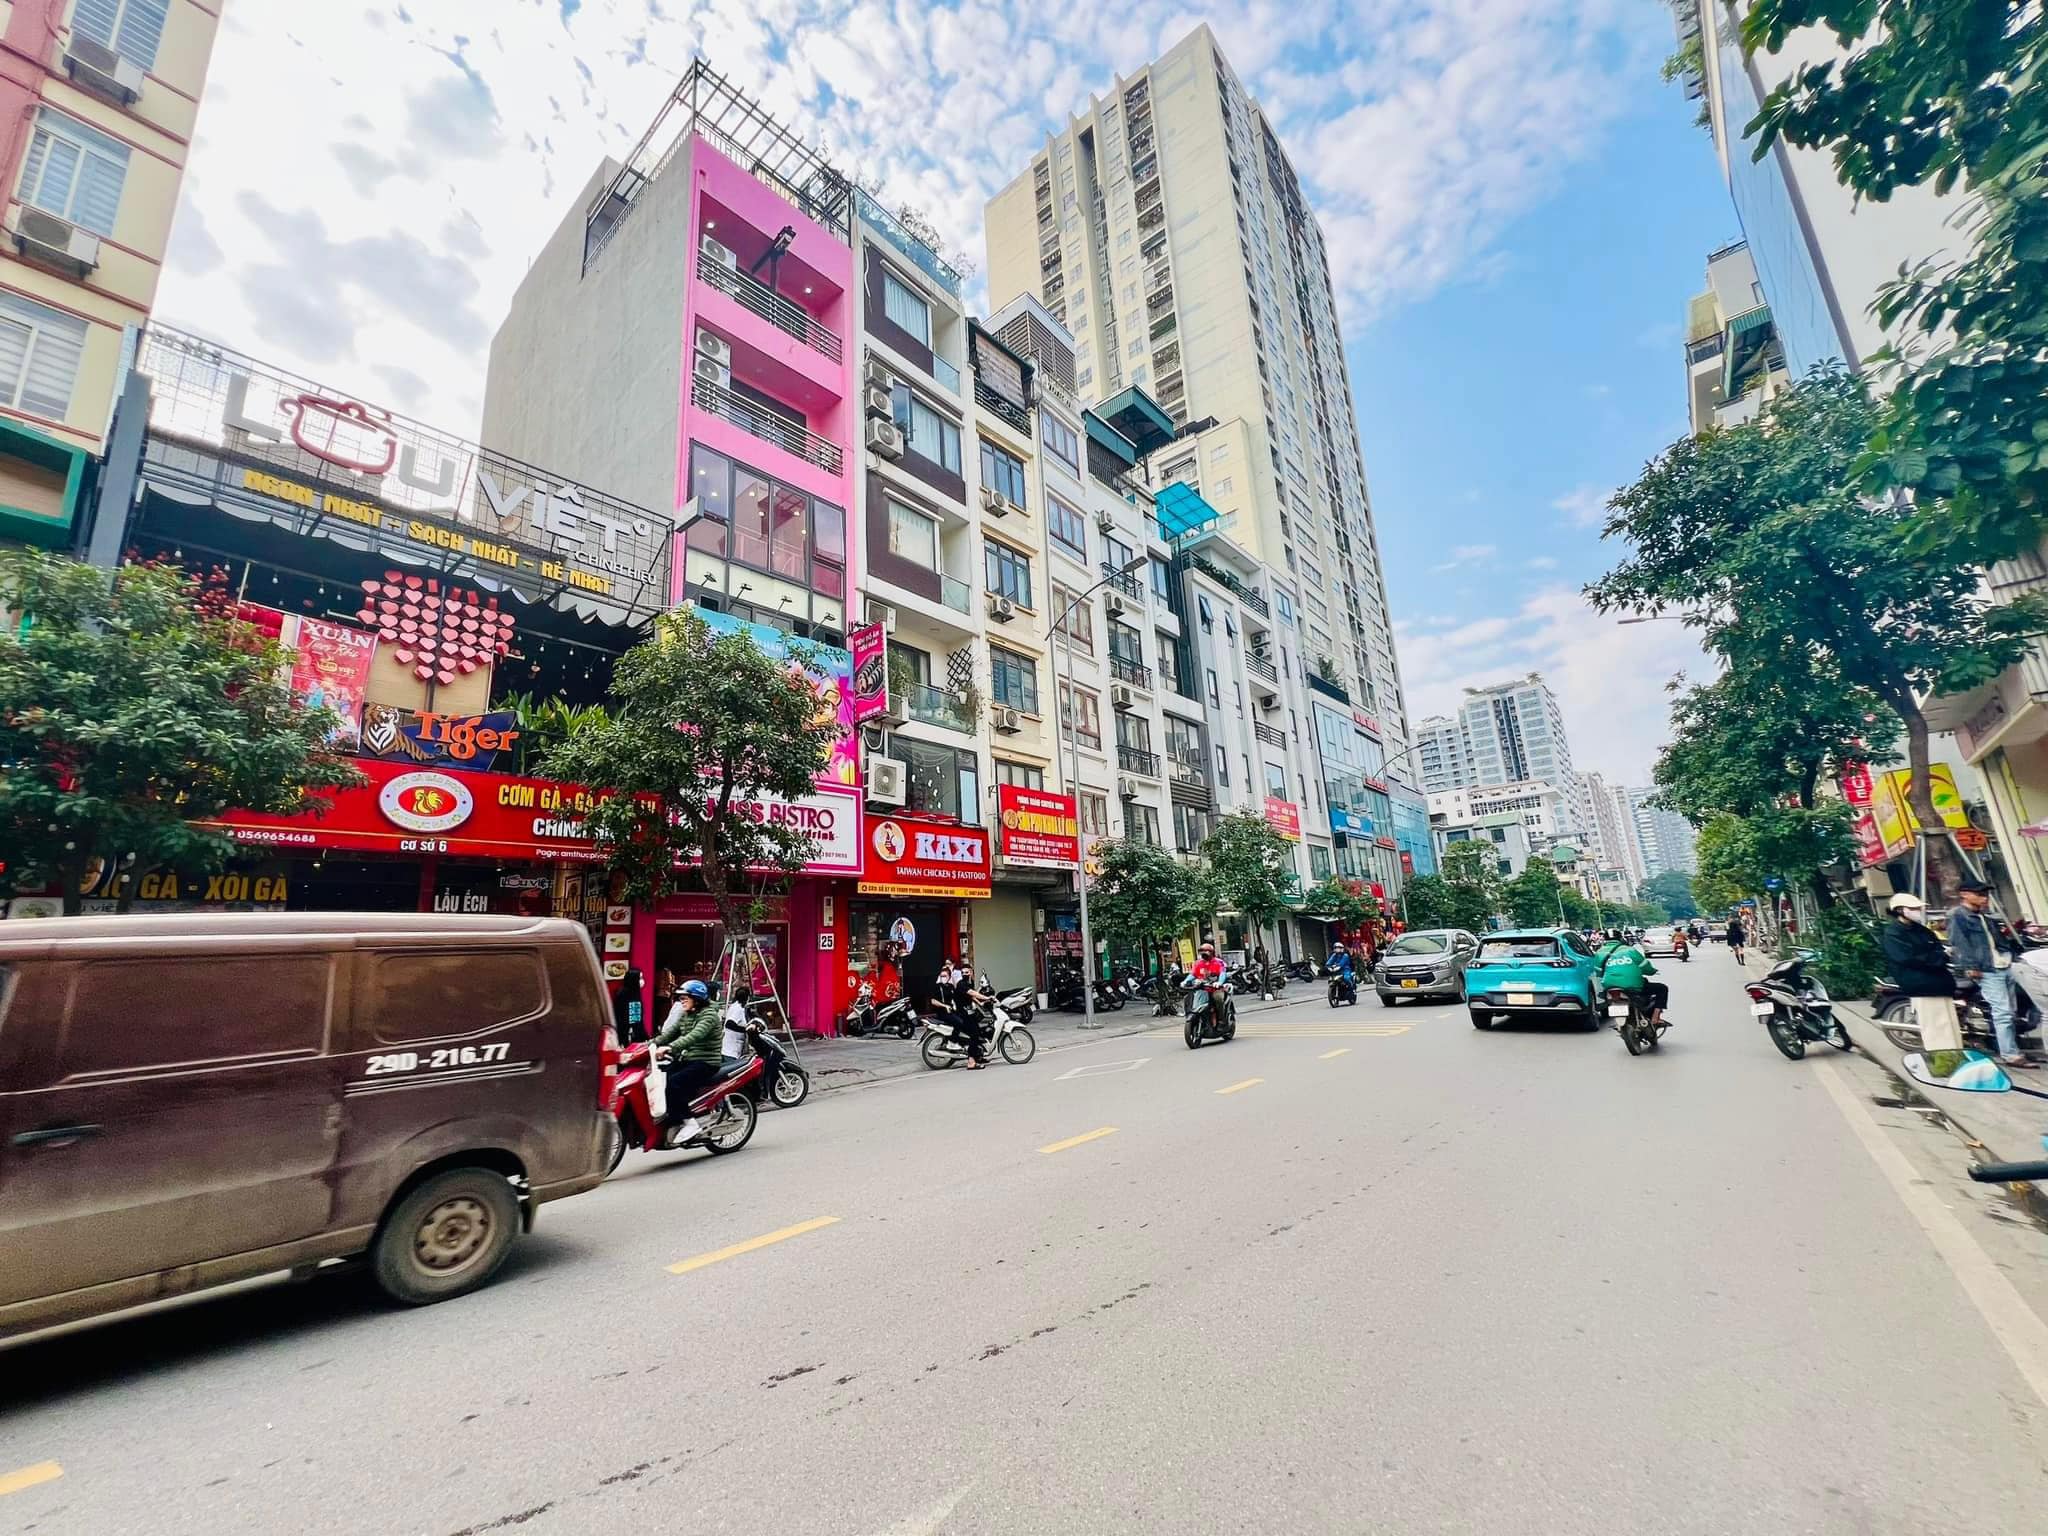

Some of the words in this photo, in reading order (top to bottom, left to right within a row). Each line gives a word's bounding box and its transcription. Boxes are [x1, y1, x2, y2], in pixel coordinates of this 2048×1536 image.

[408, 521, 465, 553] SẠCH
[414, 710, 519, 760] Tiger
[499, 783, 535, 808] CƠM
[769, 803, 835, 830] BISTRO
[438, 840, 447, 851] 6
[535, 848, 560, 859] Page:
[915, 832, 983, 863] KAXI
[205, 871, 249, 900] XÔI
[923, 868, 951, 878] CHICKEN
[957, 871, 986, 880] FASTFOOD
[821, 935, 833, 948] 25
[365, 1042, 511, 1075] 29D-216.77
